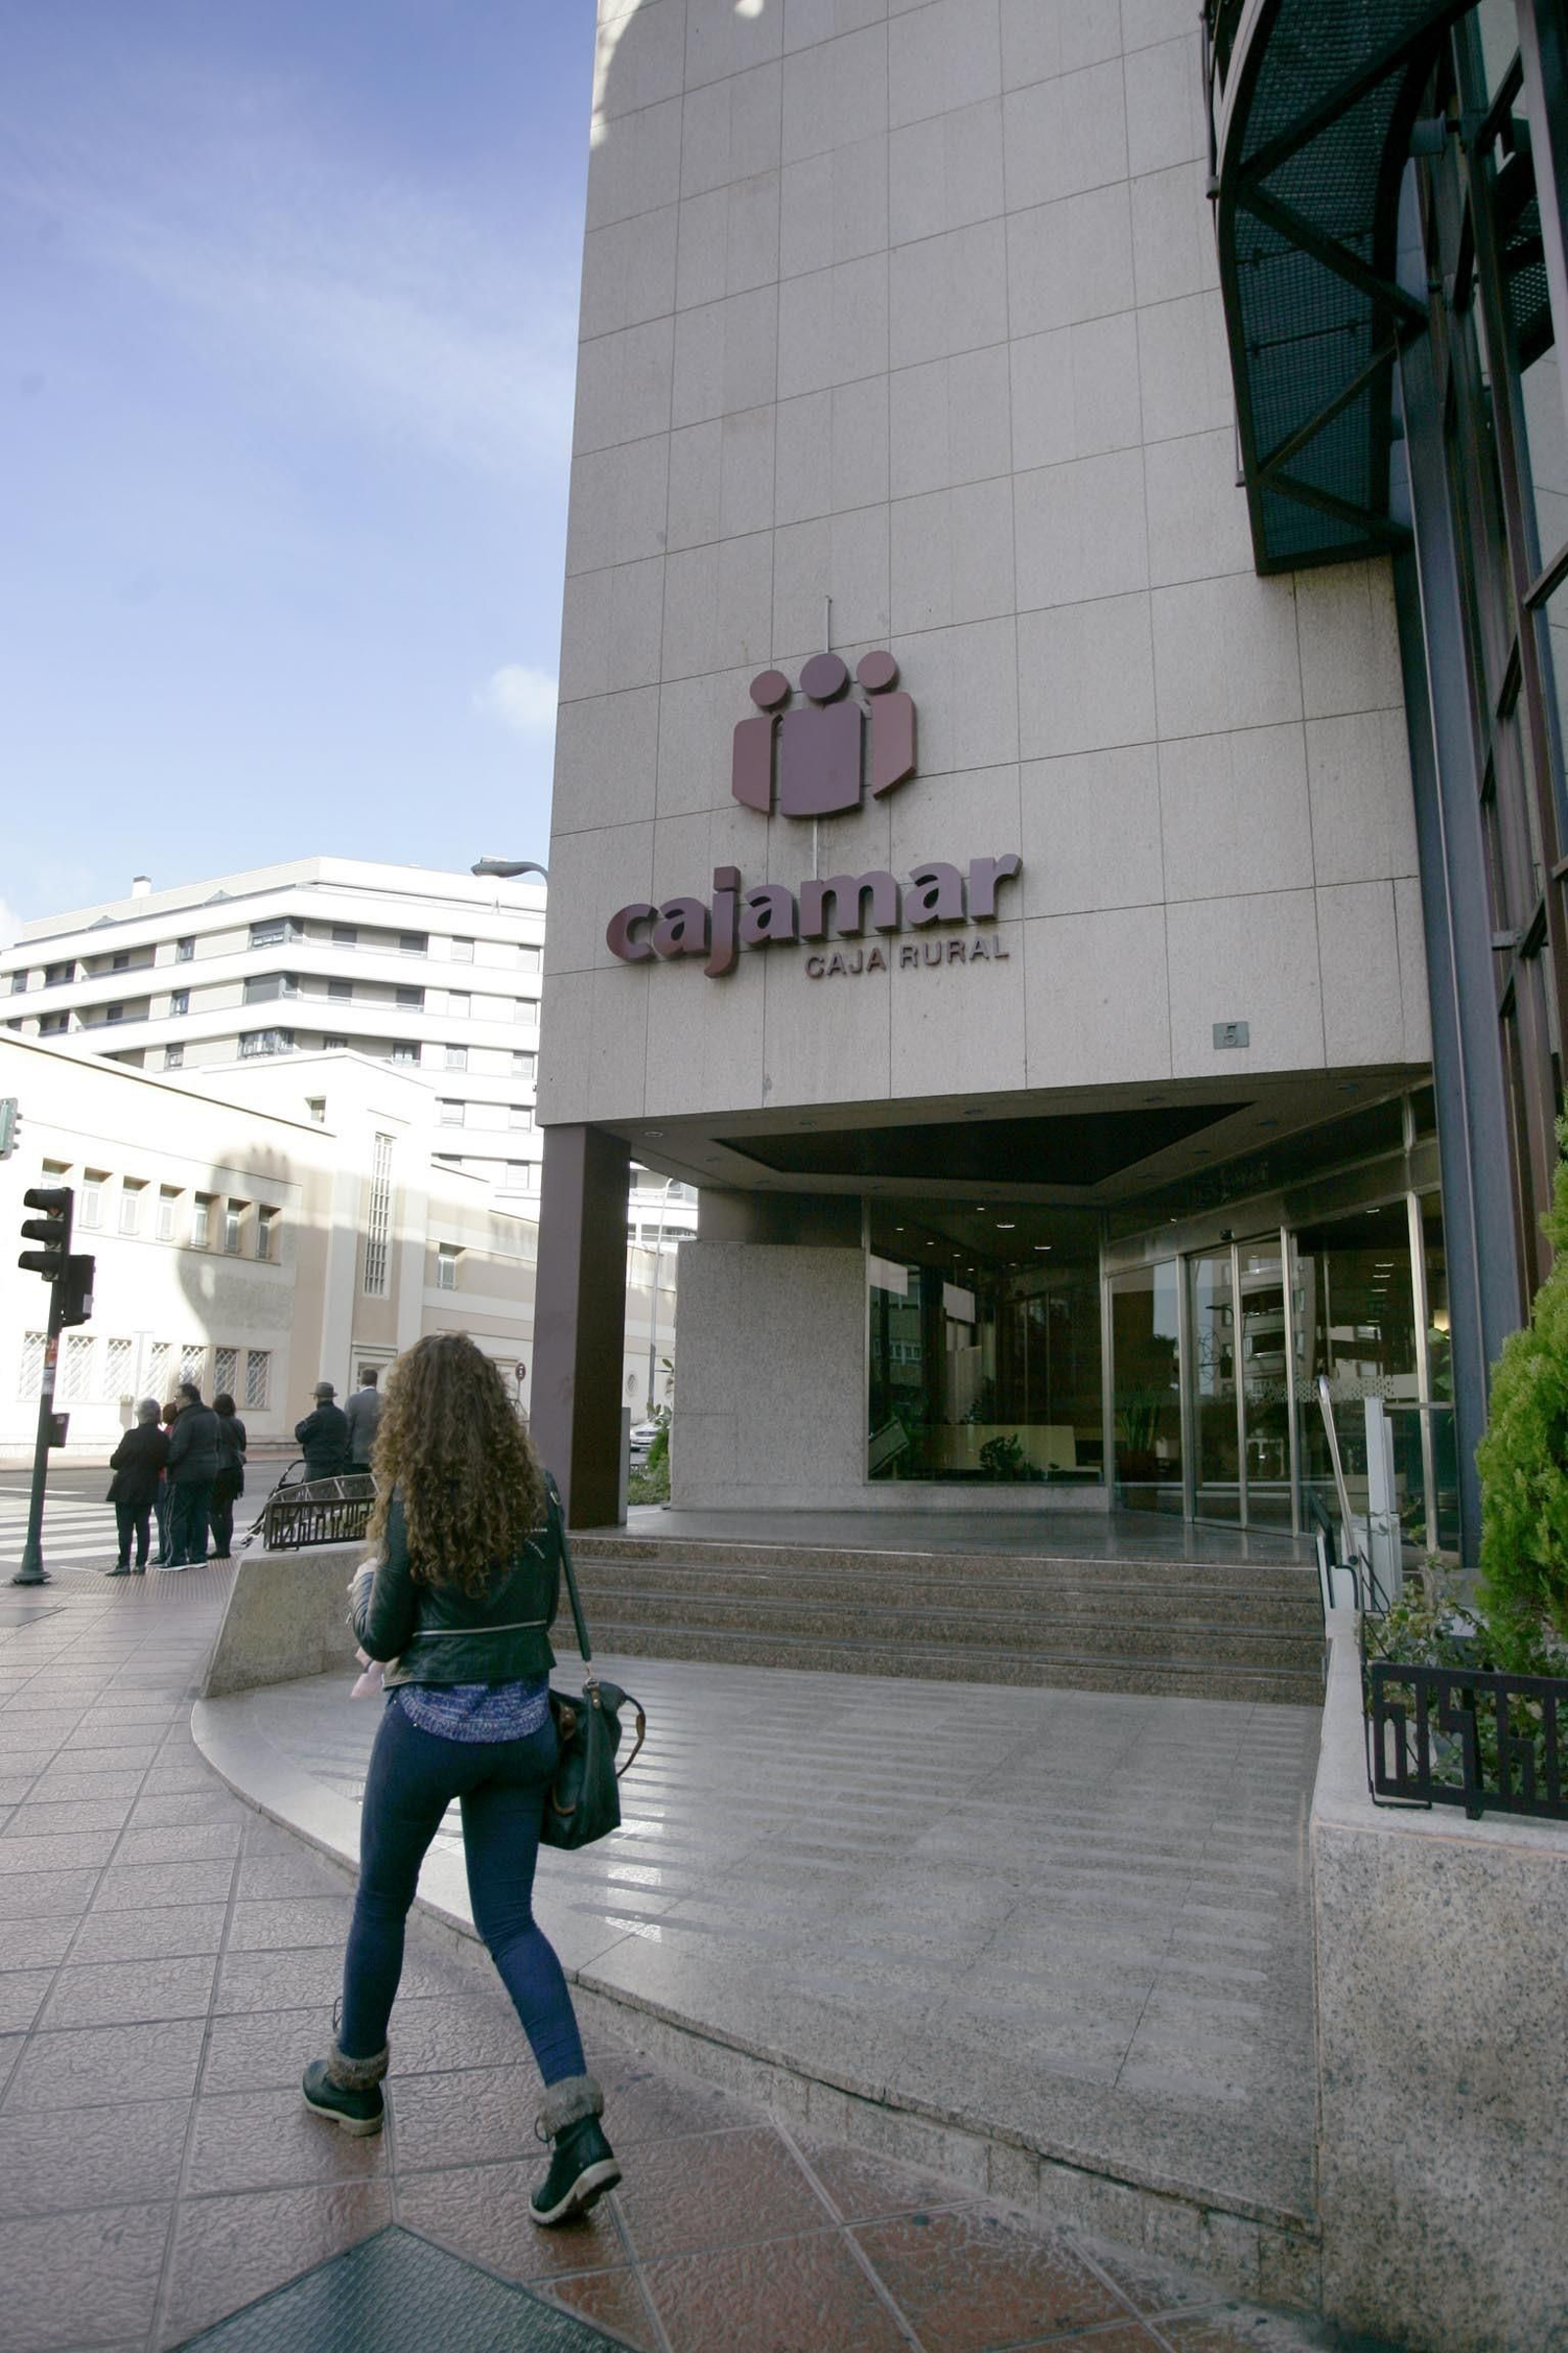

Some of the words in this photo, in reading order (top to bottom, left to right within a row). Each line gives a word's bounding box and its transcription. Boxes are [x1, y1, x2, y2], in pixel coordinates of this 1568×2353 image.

[607, 854, 1023, 978] cajamar
[806, 947, 886, 978] CAJA
[900, 934, 1009, 968] RURAL
[1225, 1024, 1238, 1046] 5
